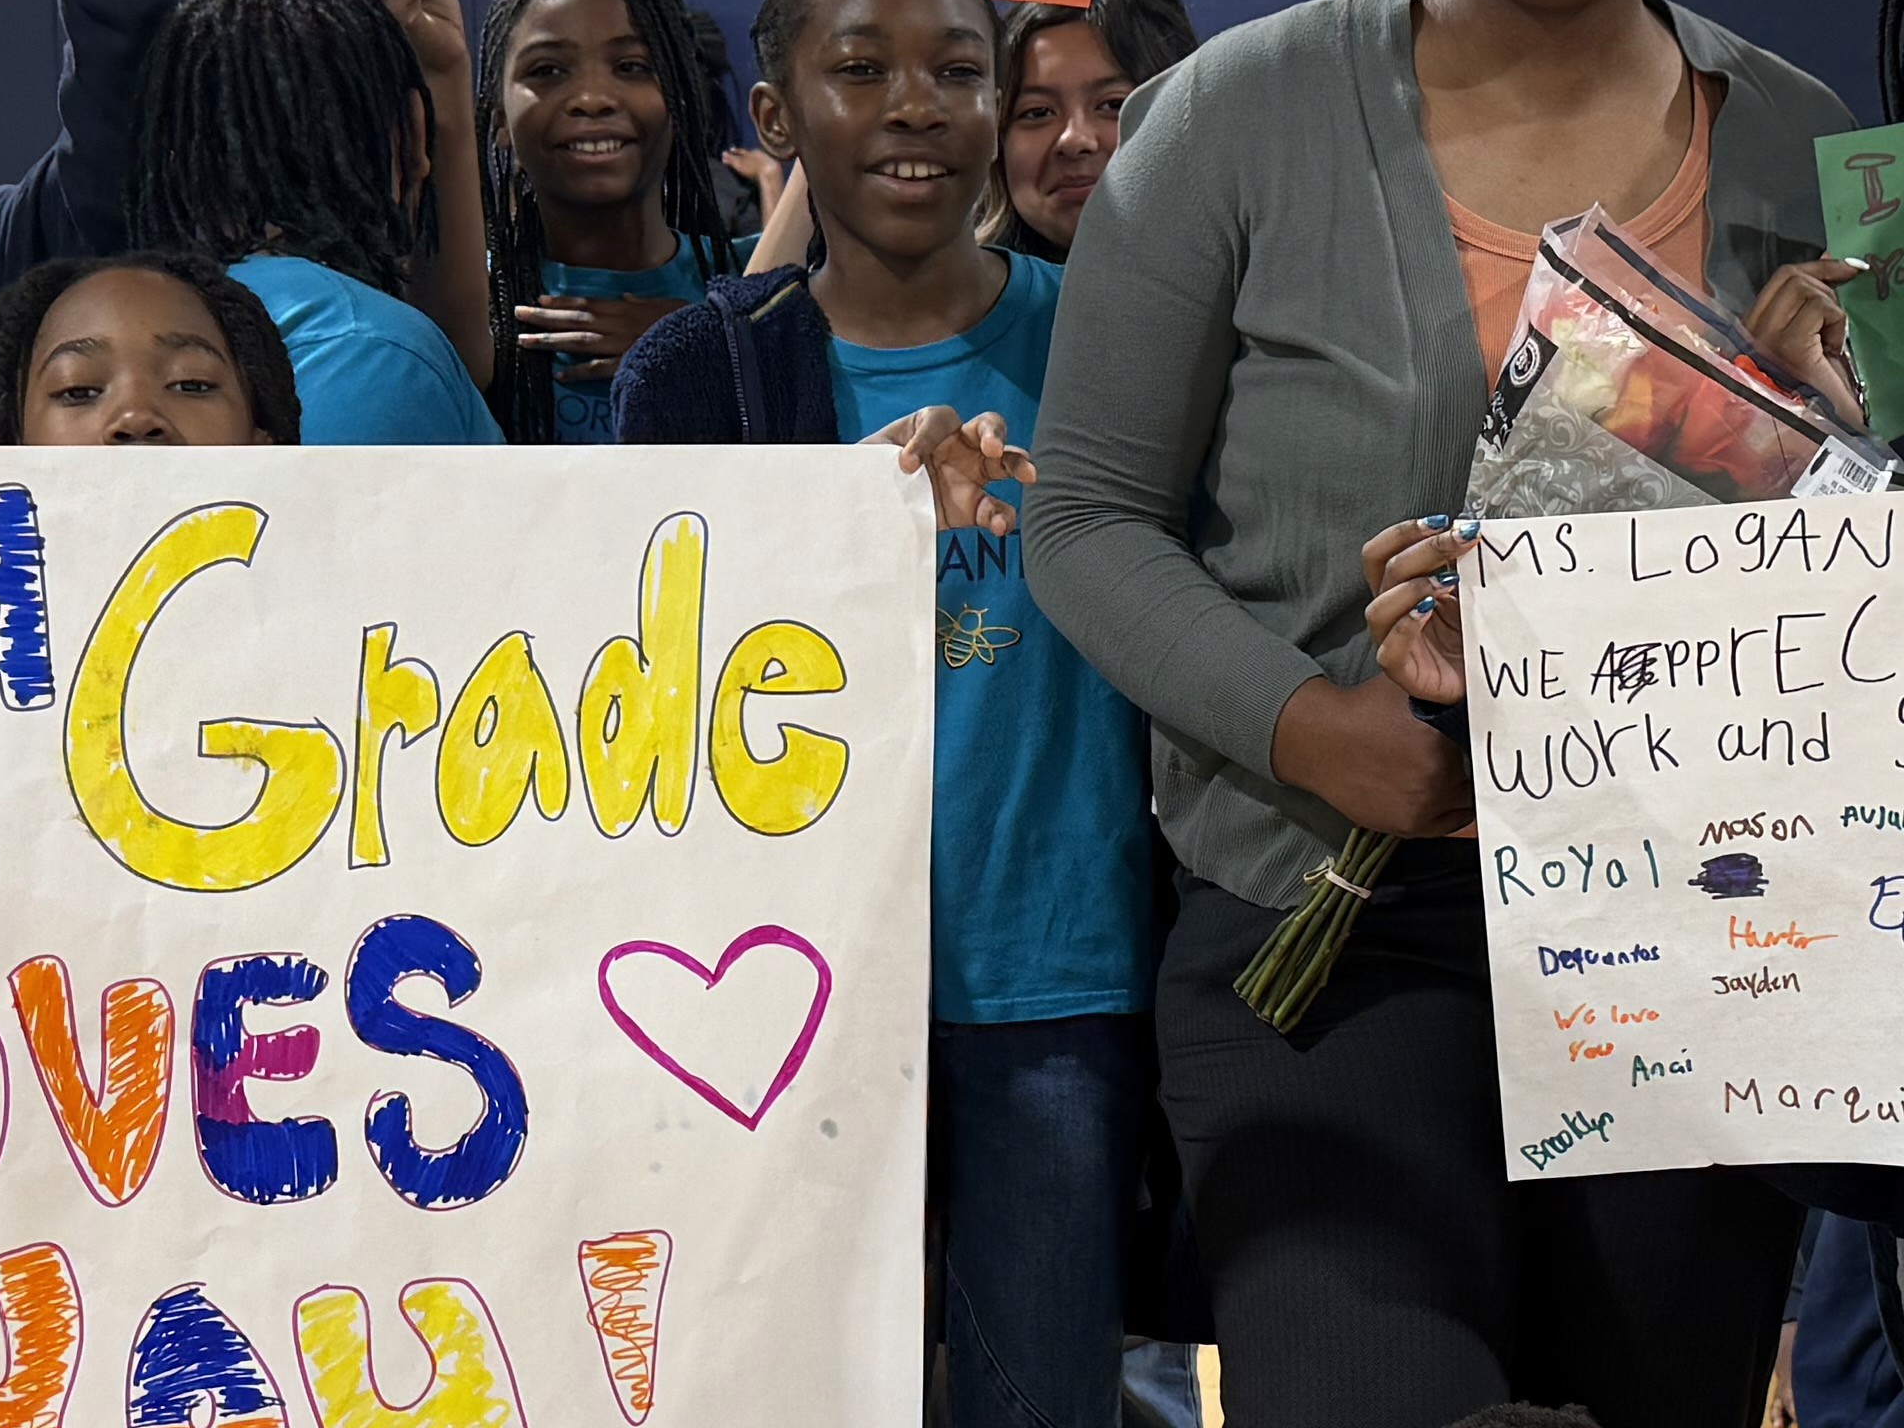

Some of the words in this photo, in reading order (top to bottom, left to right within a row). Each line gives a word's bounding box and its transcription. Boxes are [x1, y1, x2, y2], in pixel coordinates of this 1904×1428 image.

[1845, 153, 1900, 225] I
[62, 502, 848, 892] Grade
[1480, 645, 1566, 700] WE
[1717, 711, 1831, 766] and
[1497, 839, 1661, 904] Royal
